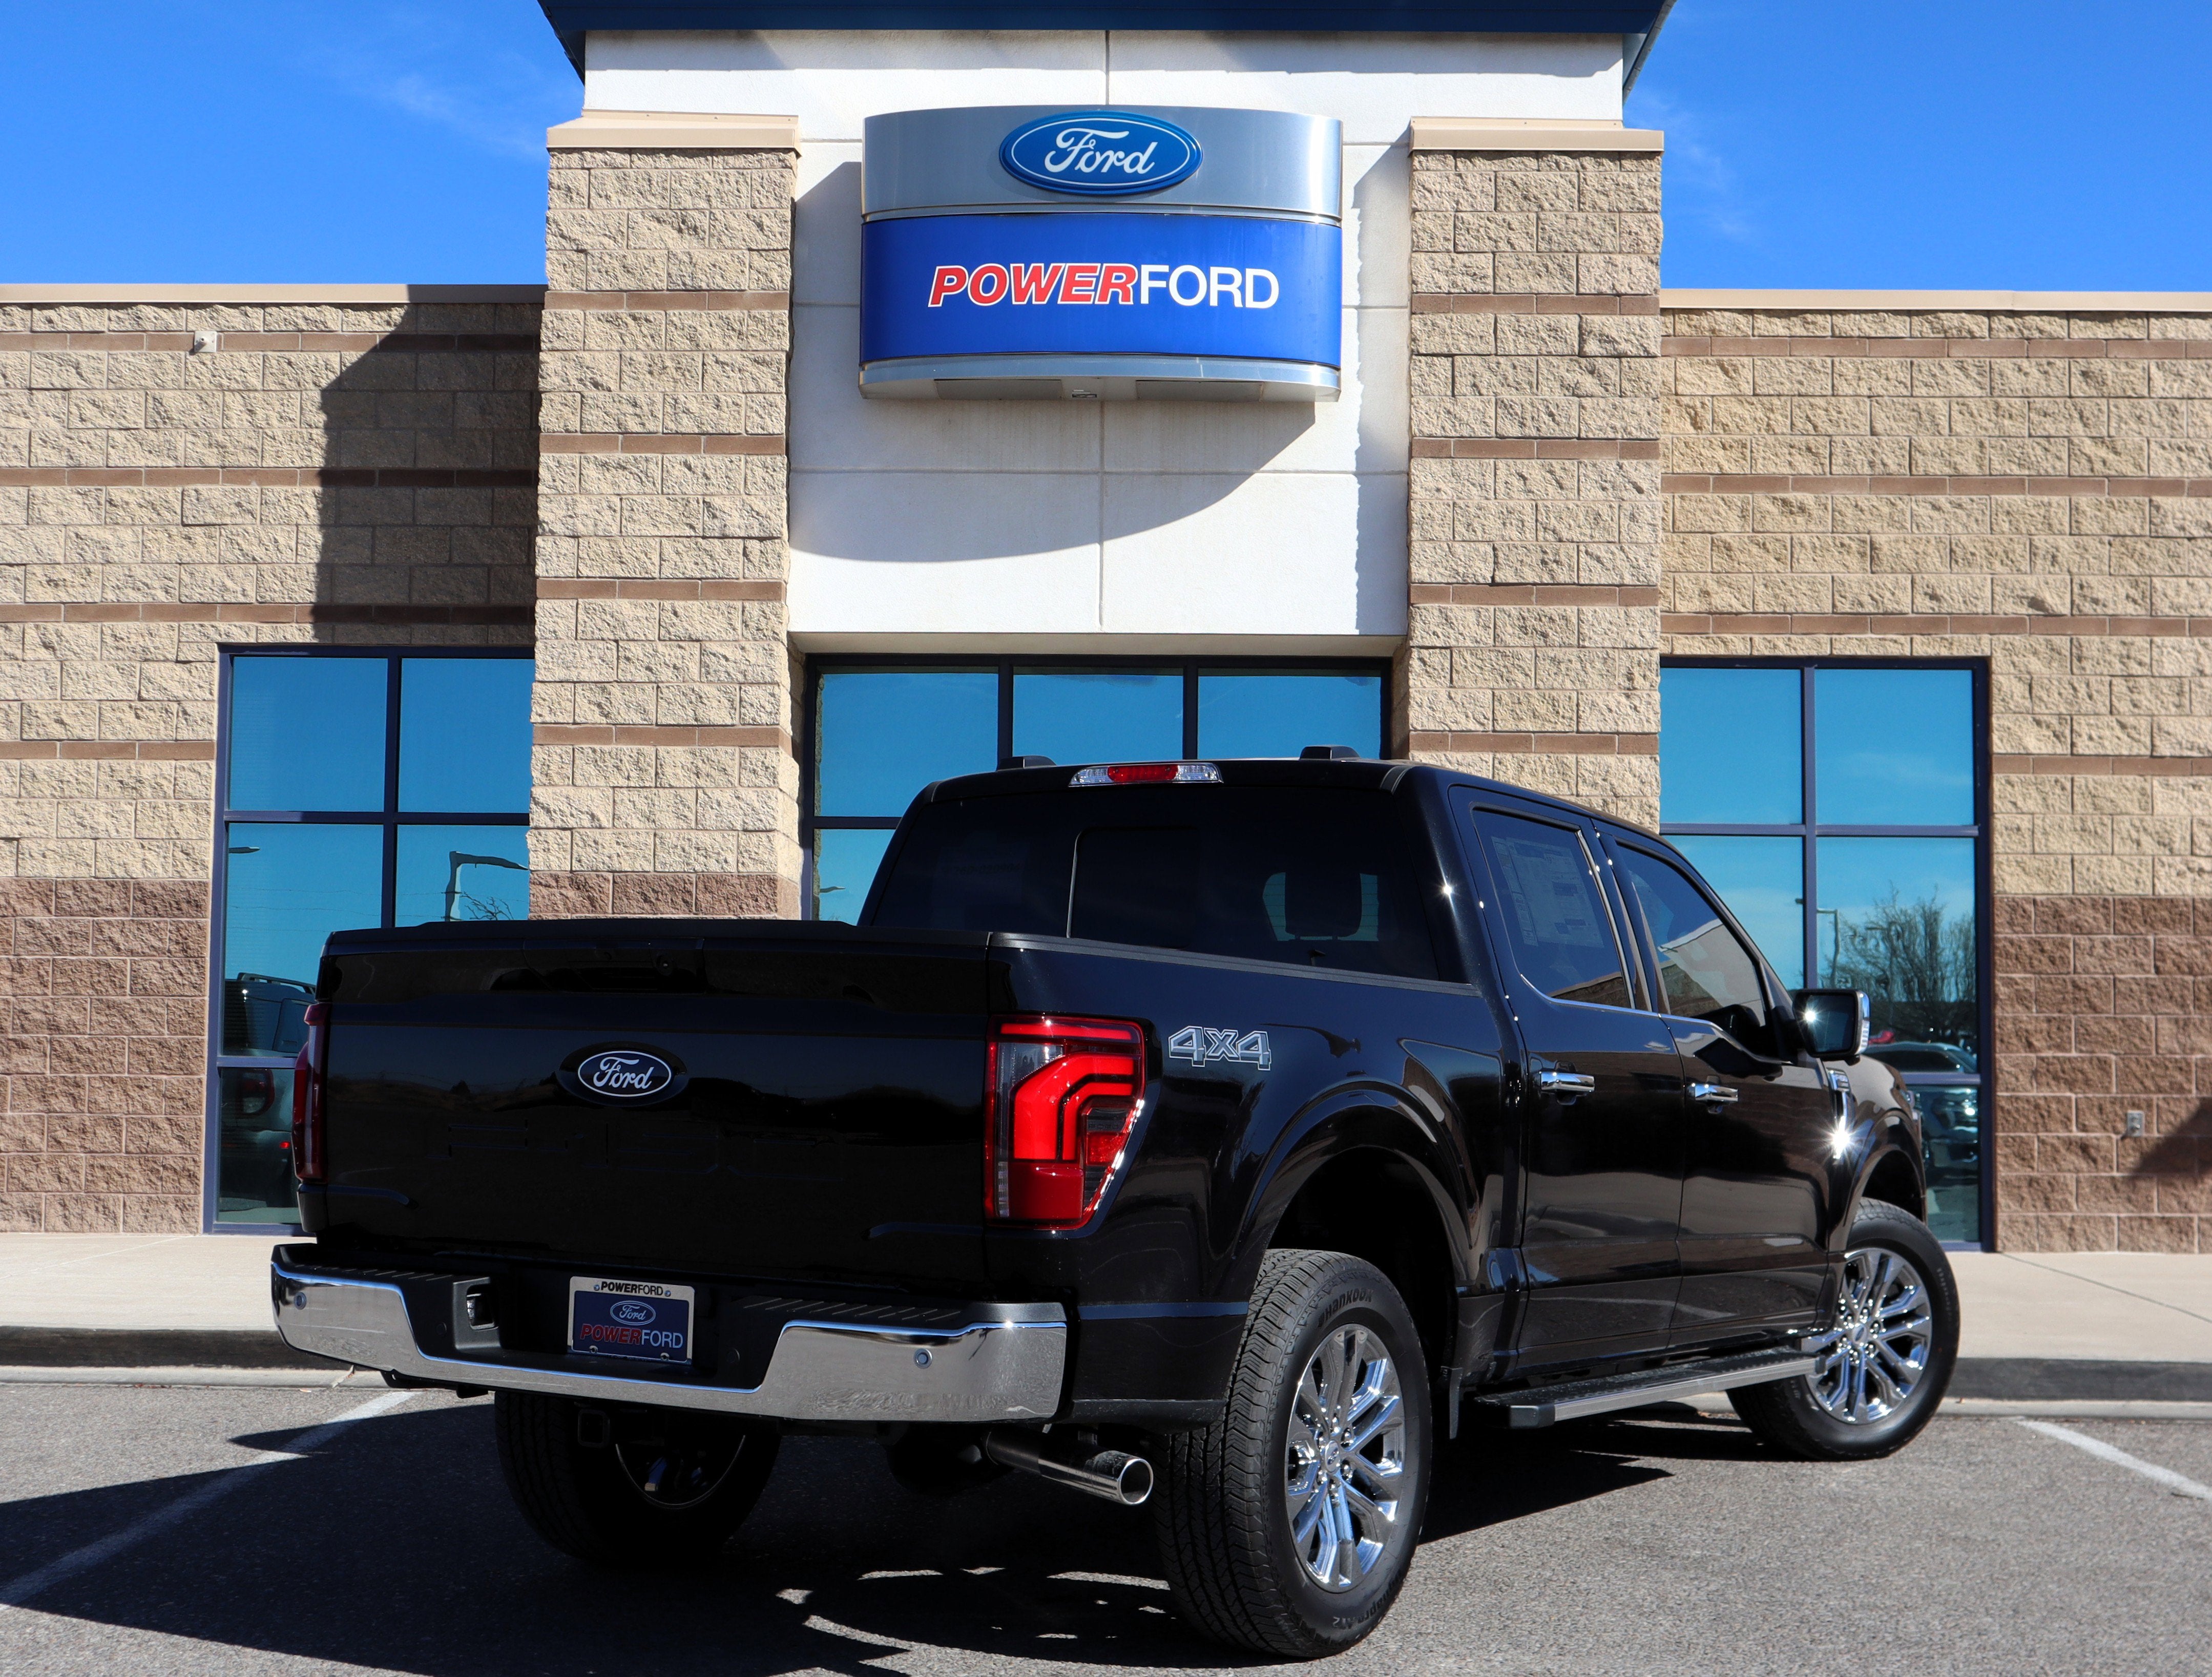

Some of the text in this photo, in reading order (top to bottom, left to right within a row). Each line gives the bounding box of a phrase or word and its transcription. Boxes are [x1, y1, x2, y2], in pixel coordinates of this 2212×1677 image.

[1044, 128, 1157, 175] Ford
[928, 263, 1279, 309] POWERFORD
[593, 1057, 654, 1089] Ford
[601, 1281, 663, 1296] POWERFORD
[619, 1305, 646, 1320] Ford
[580, 1323, 683, 1349] POWERFORD
